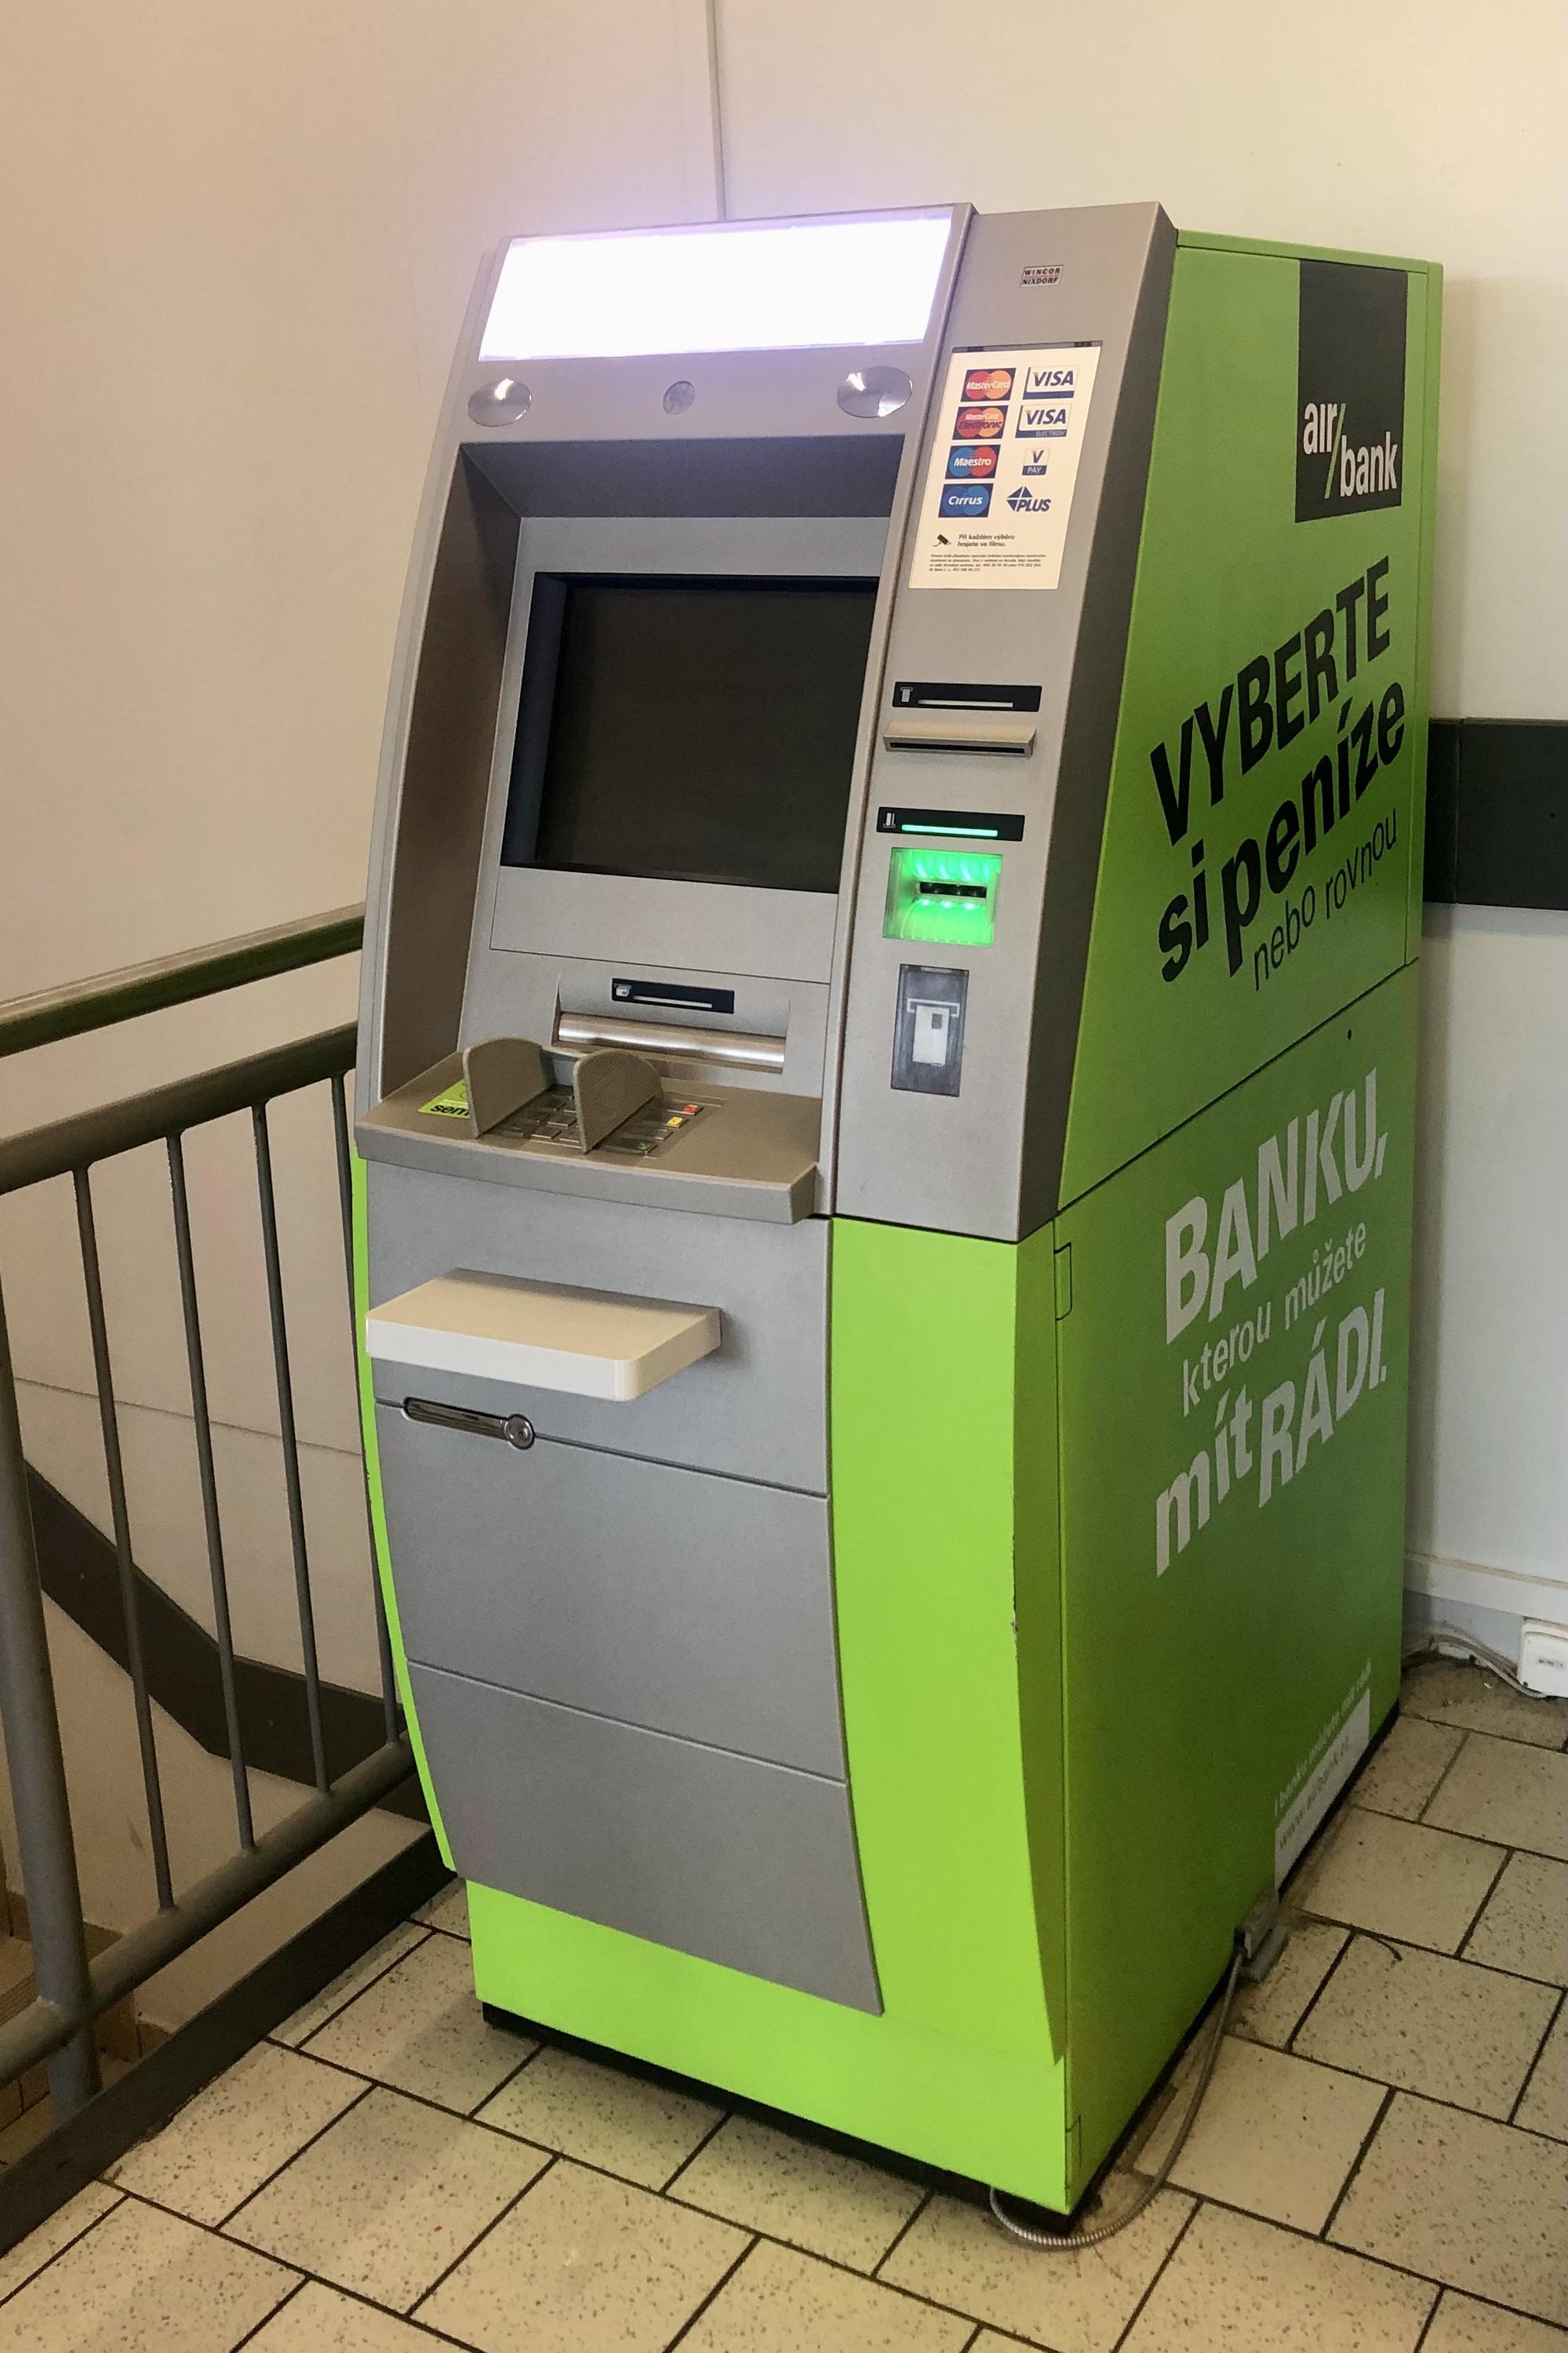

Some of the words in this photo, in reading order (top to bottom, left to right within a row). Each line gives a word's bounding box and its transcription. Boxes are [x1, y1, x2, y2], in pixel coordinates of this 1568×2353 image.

[966, 380, 1011, 391] MasterCard
[1032, 370, 1074, 387] VISA
[959, 421, 1002, 430] Electronic
[1026, 409, 1067, 425] VISA
[954, 457, 992, 467] Maestro
[1031, 449, 1045, 464] V
[1340, 431, 1398, 498] bank
[948, 496, 983, 506] Cirrus
[1016, 499, 1052, 512] PLUS
[1149, 555, 1390, 847] VYBERTE
[1158, 838, 1210, 984] si
[1221, 682, 1406, 978] peníze
[1255, 885, 1316, 991] nebo
[1325, 808, 1398, 920] rovnou
[1165, 1067, 1388, 1346] BANKU,
[1182, 1300, 1271, 1417] kterou
[1285, 1220, 1366, 1330] můžete
[1156, 1383, 1253, 1579] mít
[1258, 1286, 1388, 1509] RÁDI.
